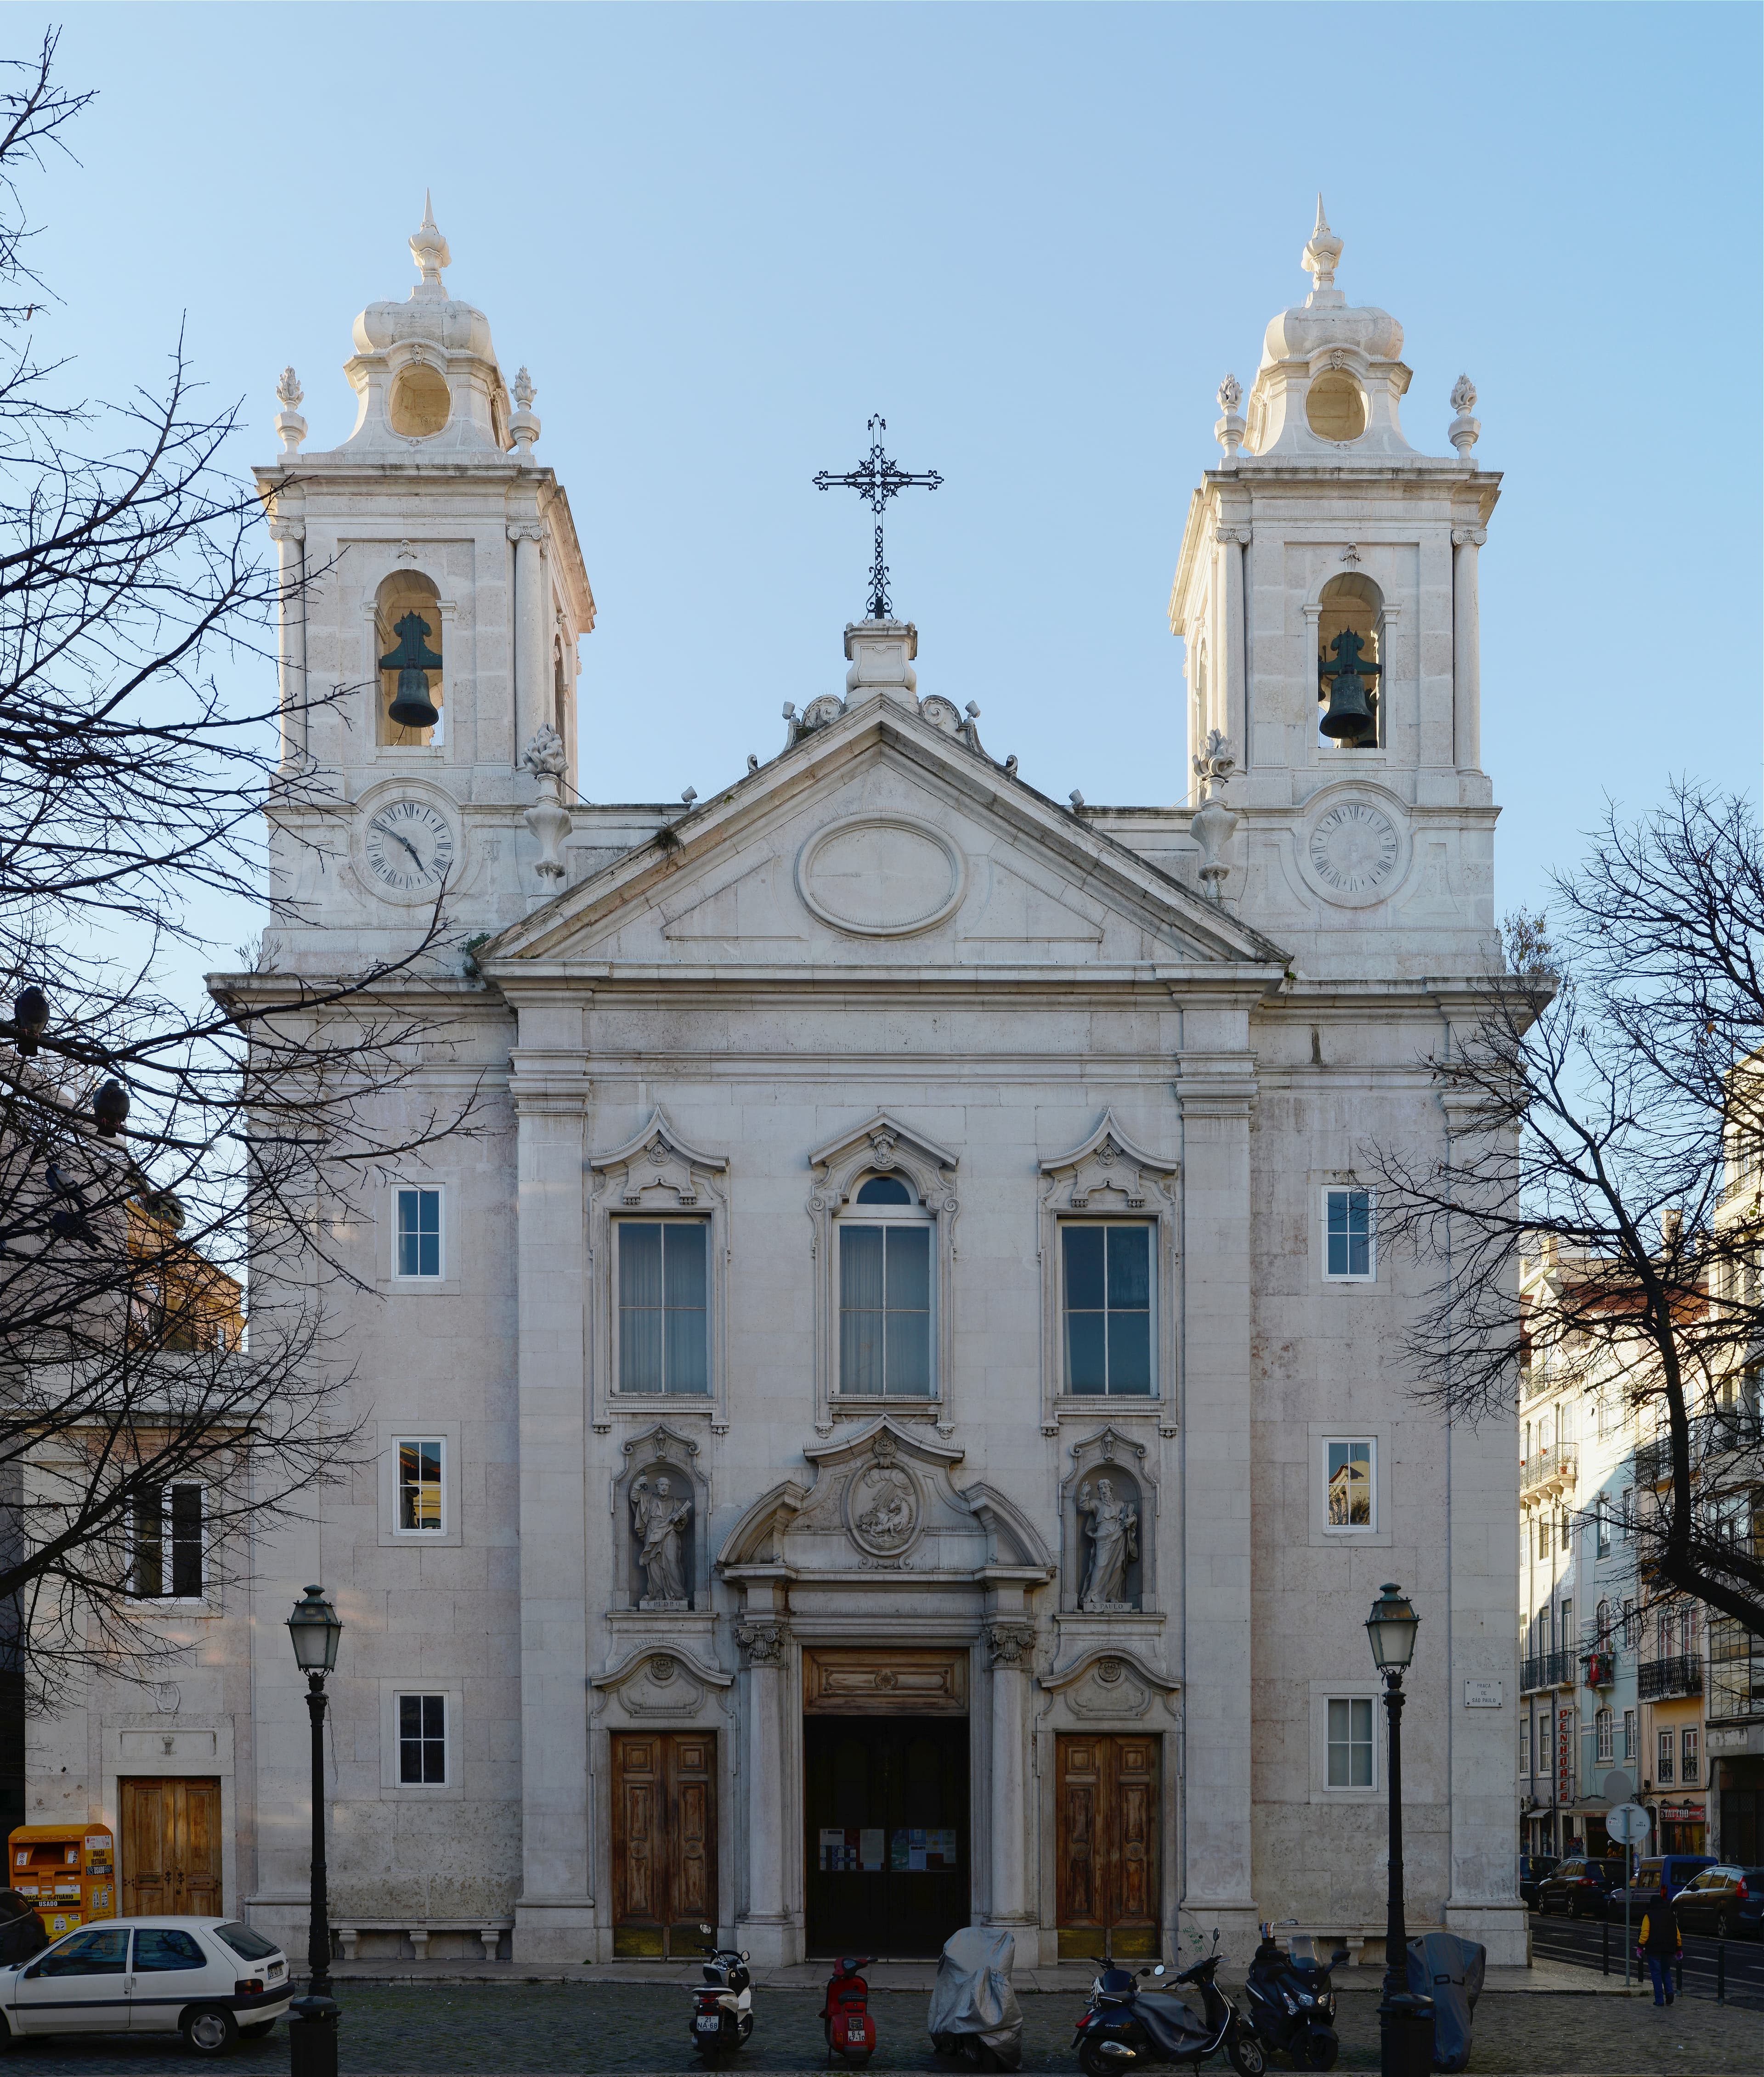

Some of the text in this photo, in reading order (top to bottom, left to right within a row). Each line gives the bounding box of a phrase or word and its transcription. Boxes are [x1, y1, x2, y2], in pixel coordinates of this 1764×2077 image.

[384, 808, 397, 822] XI
[403, 804, 414, 818] XII
[1330, 810, 1342, 824] XI
[1348, 806, 1359, 820] XII
[1664, 1809, 1689, 1818] TATTOO
[93, 1849, 104, 1857] DOAÇÃO
